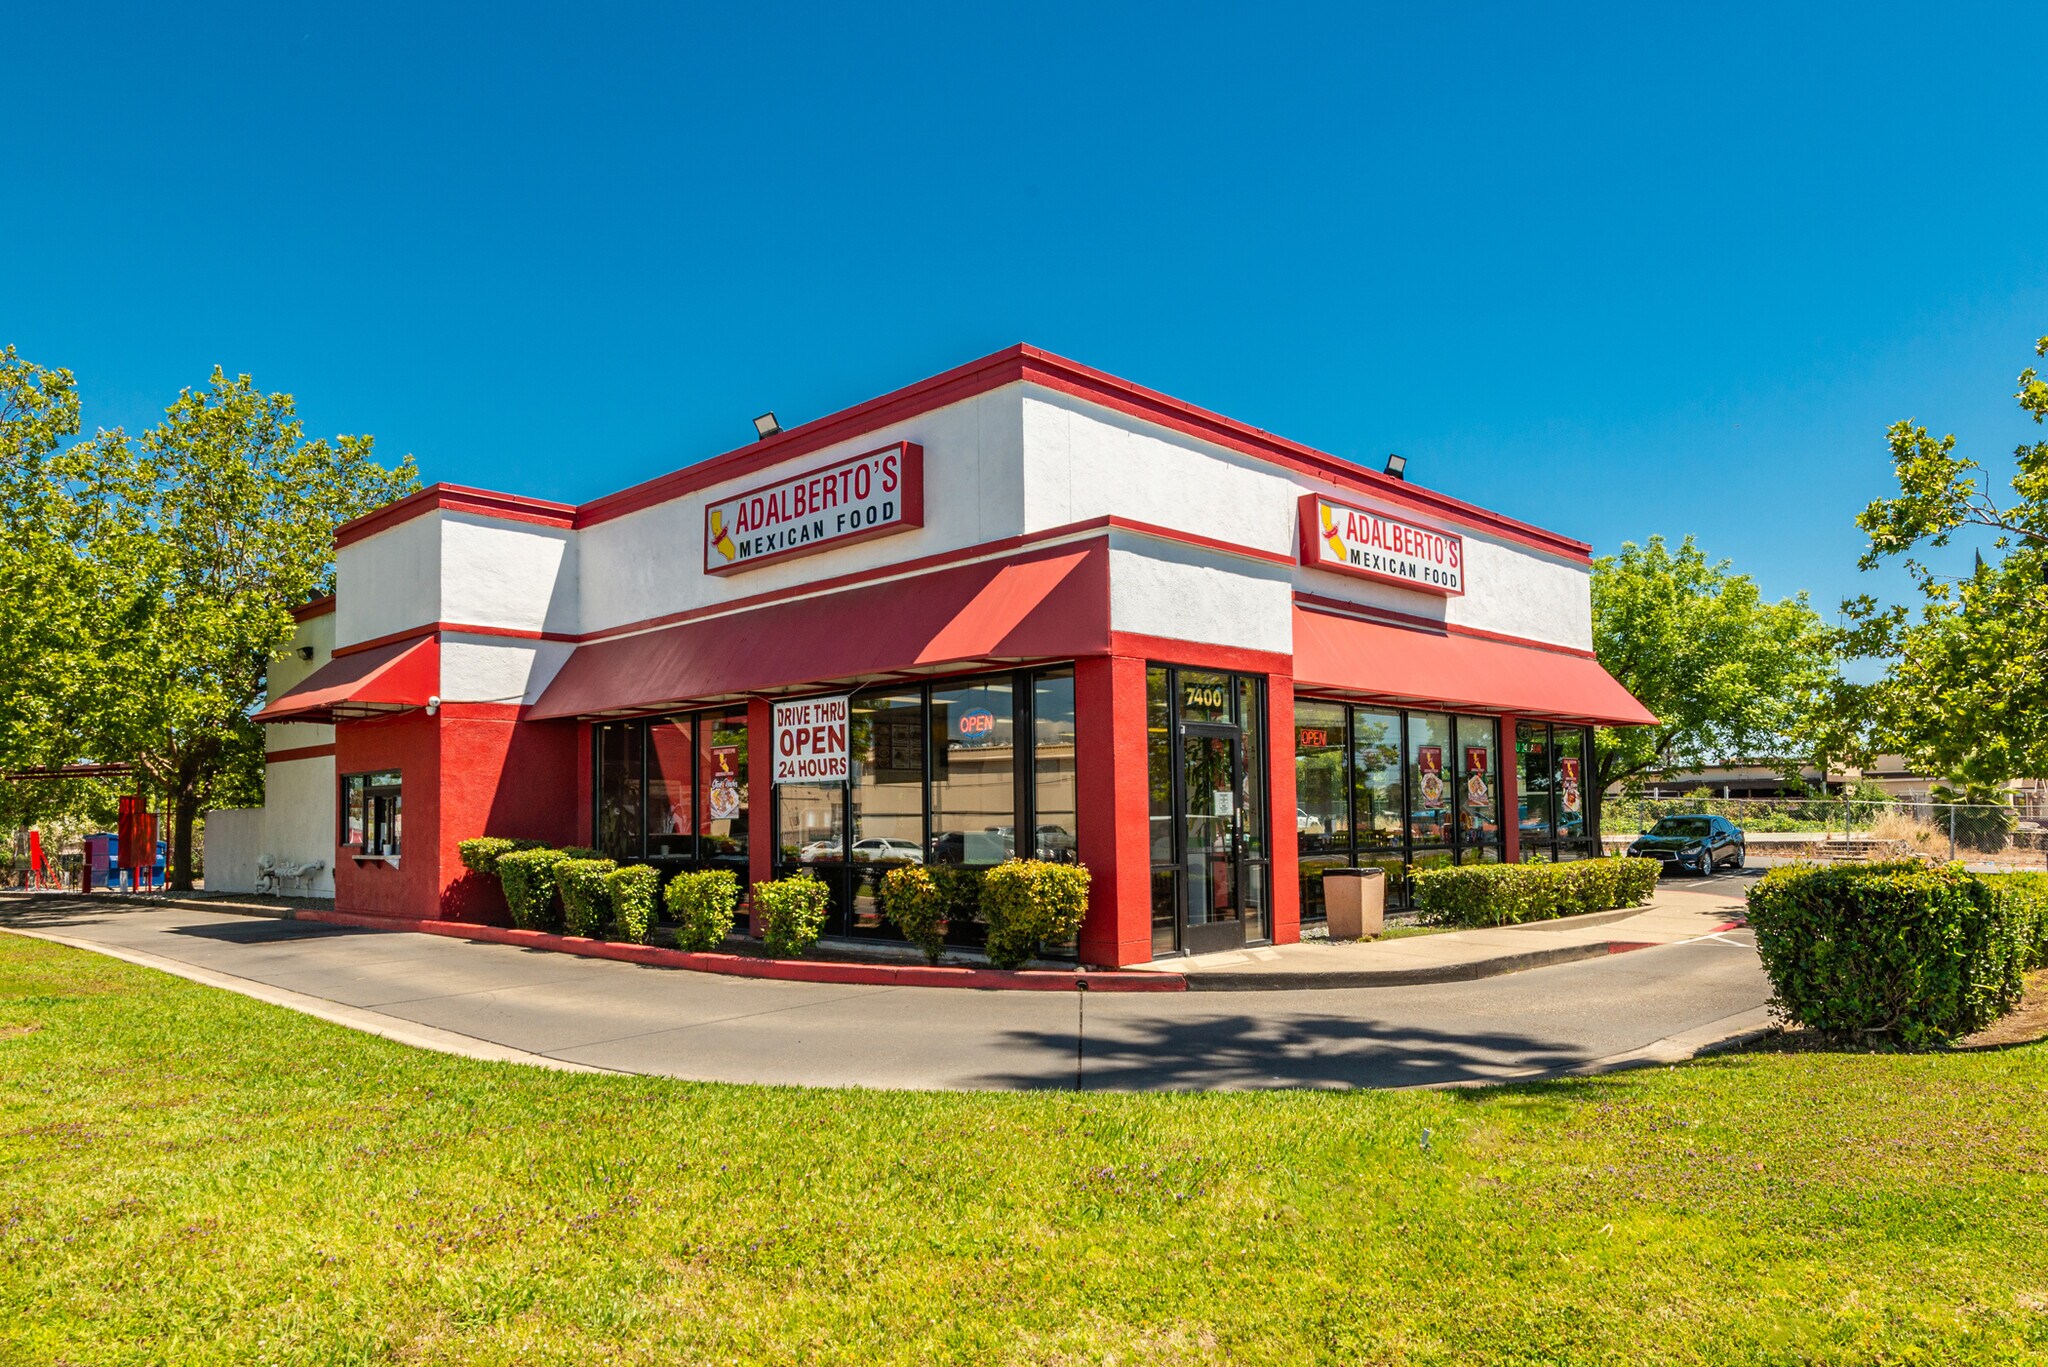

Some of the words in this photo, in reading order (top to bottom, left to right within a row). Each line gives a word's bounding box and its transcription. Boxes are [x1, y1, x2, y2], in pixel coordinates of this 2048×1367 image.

[735, 455, 898, 535] ADALBERTO'S
[739, 520, 824, 558] MEXICAN
[837, 501, 894, 532] FOOD
[1346, 511, 1459, 568] ADALBERTO'S
[1350, 548, 1416, 578] MEXICAN
[1424, 566, 1457, 588] FOOD
[1184, 687, 1222, 707] 7400
[777, 705, 810, 727] DRIVE
[814, 701, 846, 723] THRU
[959, 714, 993, 734] OPEN
[779, 724, 846, 757] OPEN
[1301, 730, 1326, 746] OPEN
[778, 760, 796, 778] 24
[799, 757, 847, 777] HOURS
